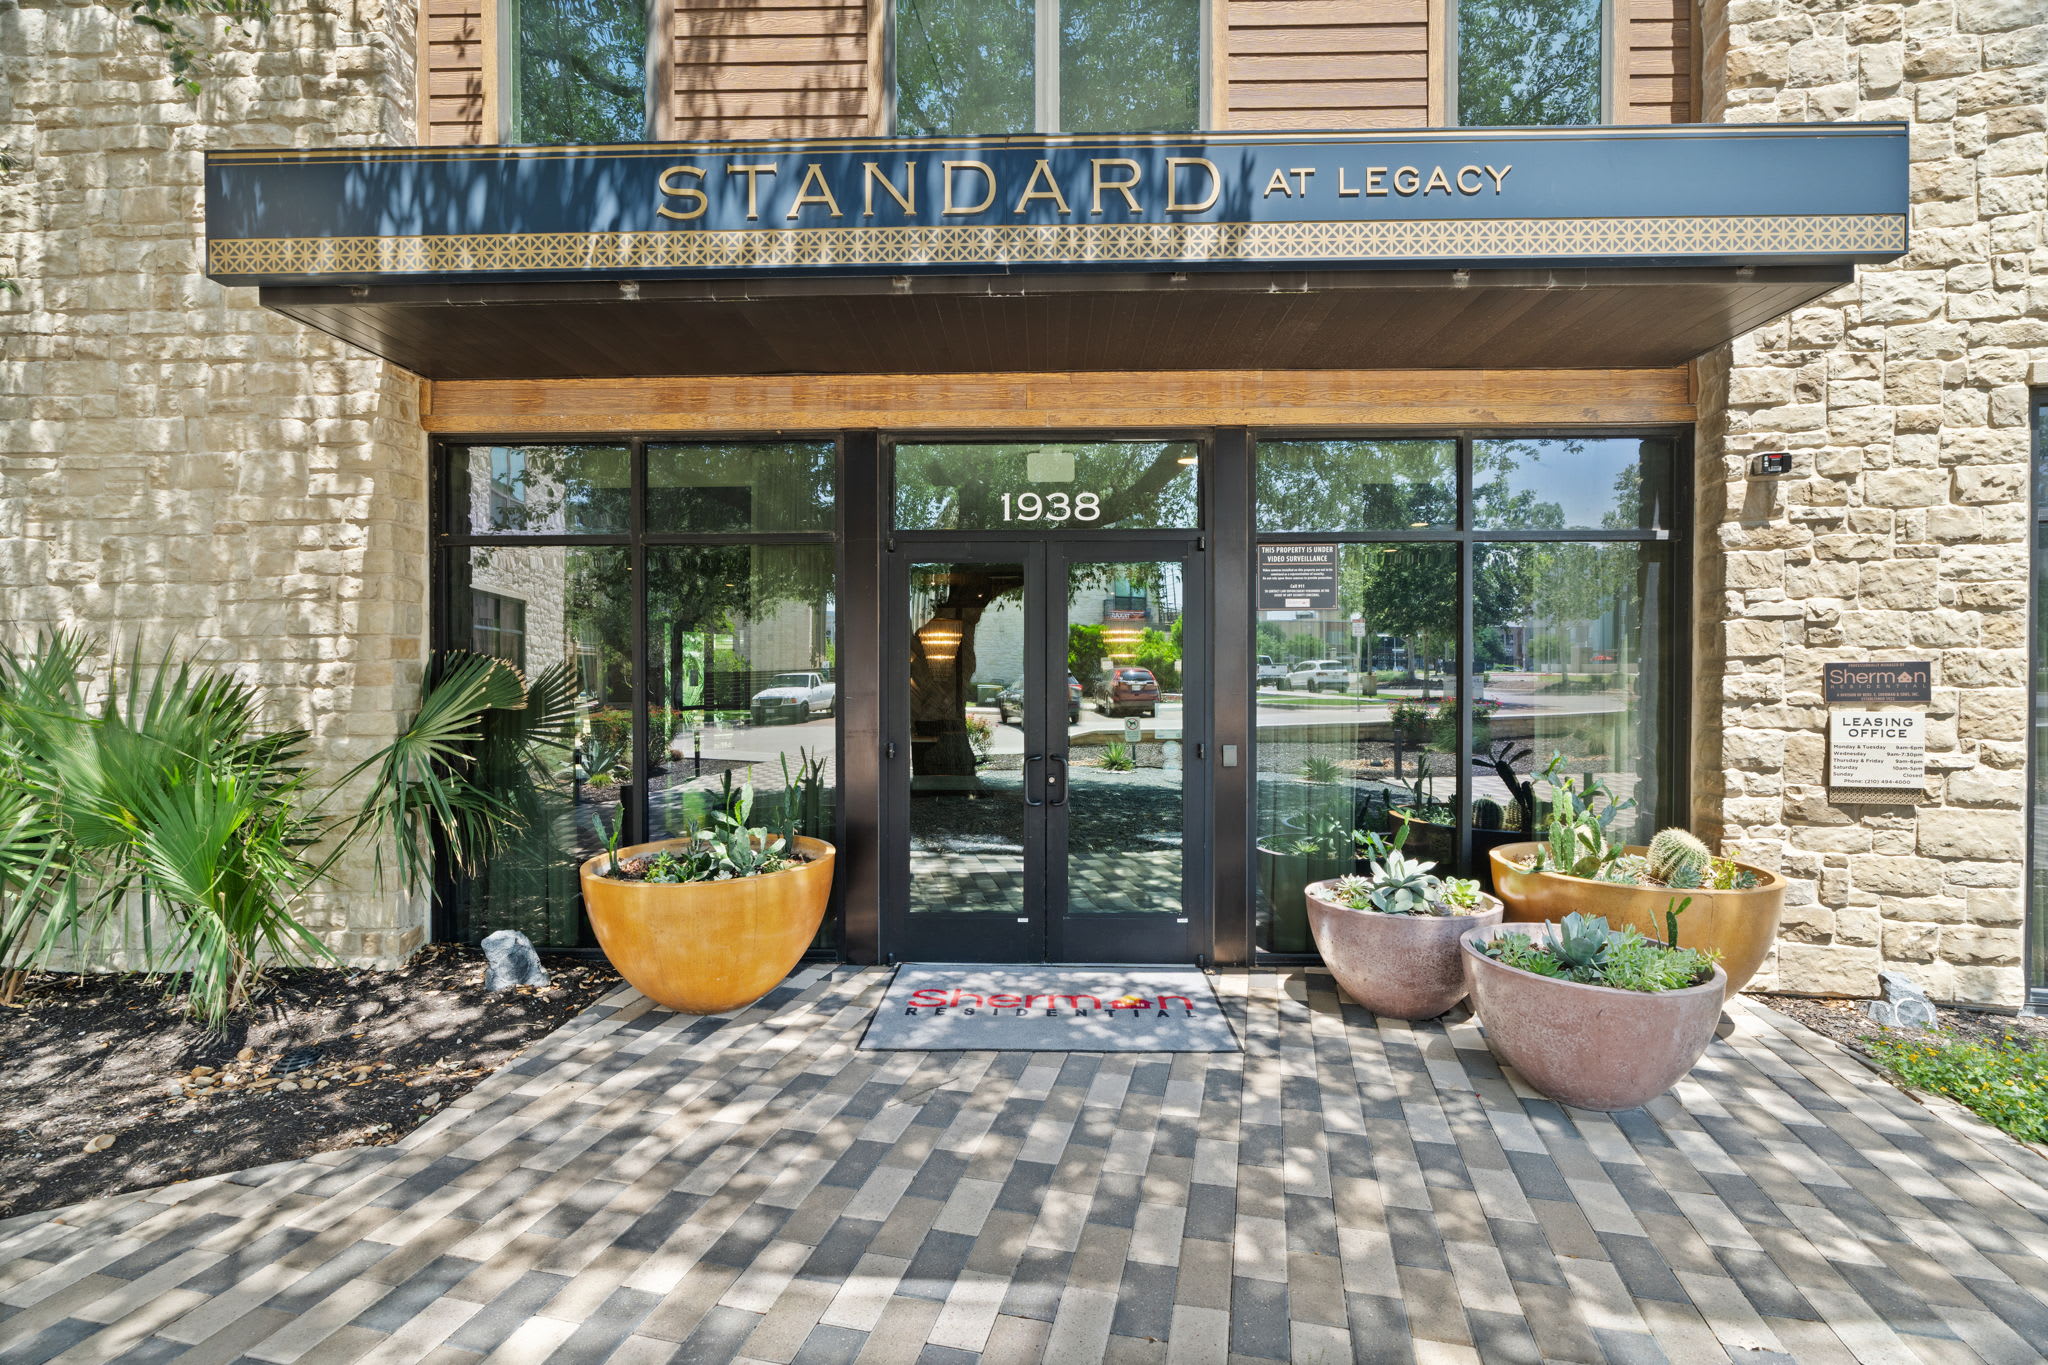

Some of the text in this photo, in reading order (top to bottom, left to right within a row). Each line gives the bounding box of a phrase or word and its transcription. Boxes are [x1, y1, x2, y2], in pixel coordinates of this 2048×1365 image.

[656, 157, 1513, 220] STANDARD AT LEGACY
[1001, 492, 1101, 521] 1938
[1842, 718, 1914, 727] LEASING
[1848, 728, 1908, 738] OFFICE
[905, 1007, 1197, 1018] RESIDENTIAL
